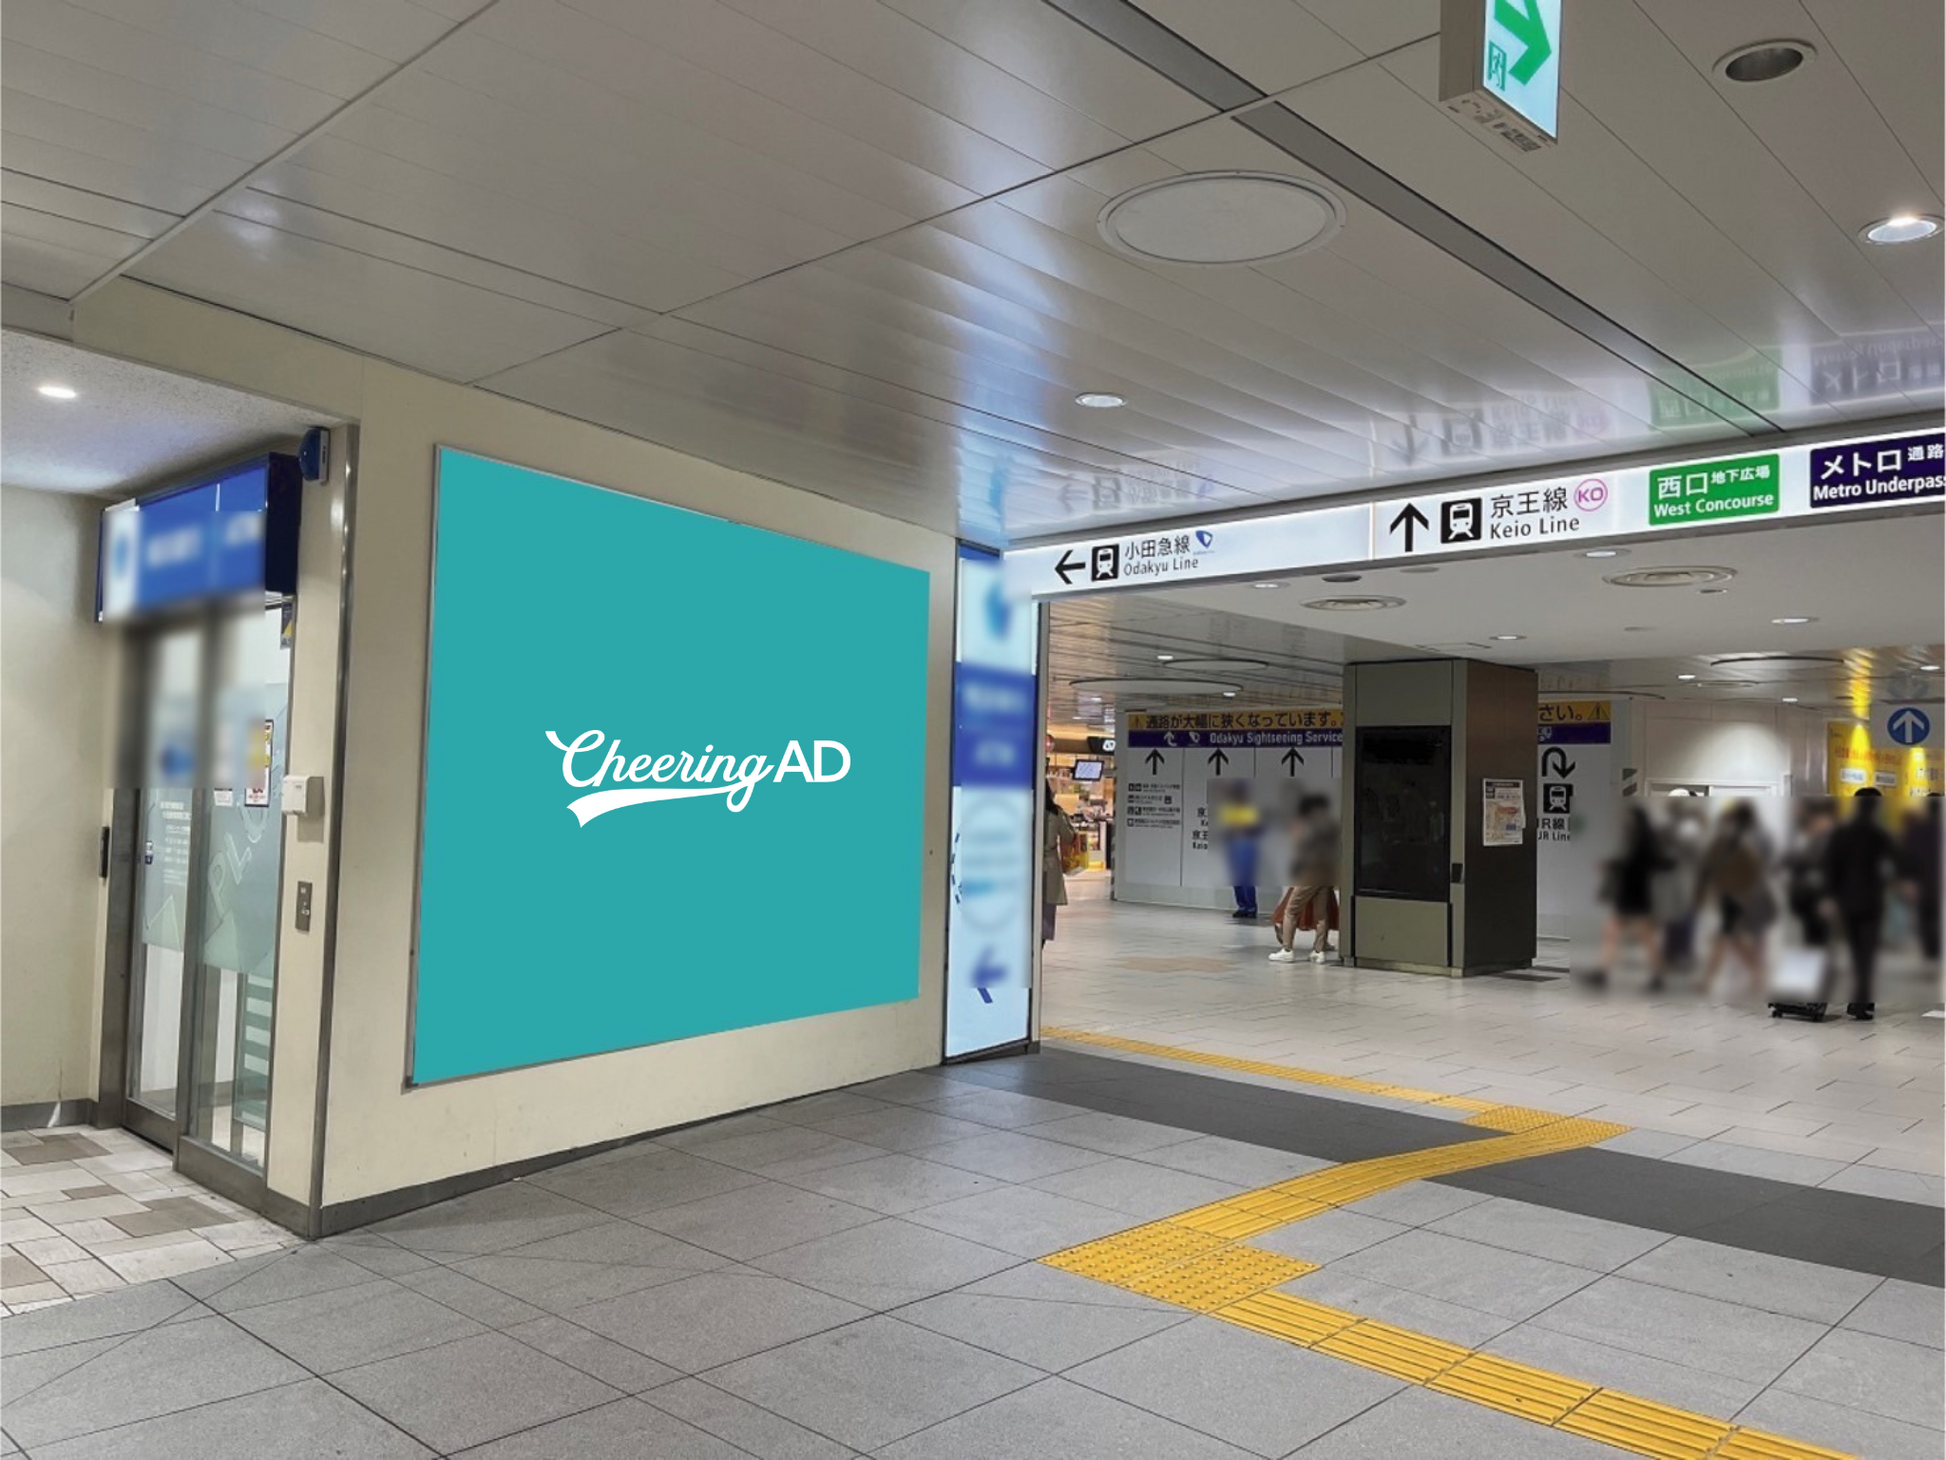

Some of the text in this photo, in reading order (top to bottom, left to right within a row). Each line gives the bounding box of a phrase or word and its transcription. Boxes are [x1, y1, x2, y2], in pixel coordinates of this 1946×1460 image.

[1820, 443, 1944, 480] メトロ 通路
[1657, 464, 1771, 500] 西口 地下広場
[1813, 484, 1862, 501] Metro
[1490, 486, 1569, 519] 京王線
[1577, 486, 1604, 503] KO
[1654, 494, 1775, 518] West Concourse
[1490, 515, 1580, 540] Keio Line
[1124, 534, 1191, 561] 小田急線
[1123, 556, 1200, 577] Odakyu Line
[1538, 705, 1583, 722] さい。
[1209, 730, 1343, 746] Odakyu Sightseeing Service
[545, 729, 852, 813] Cheering AD
